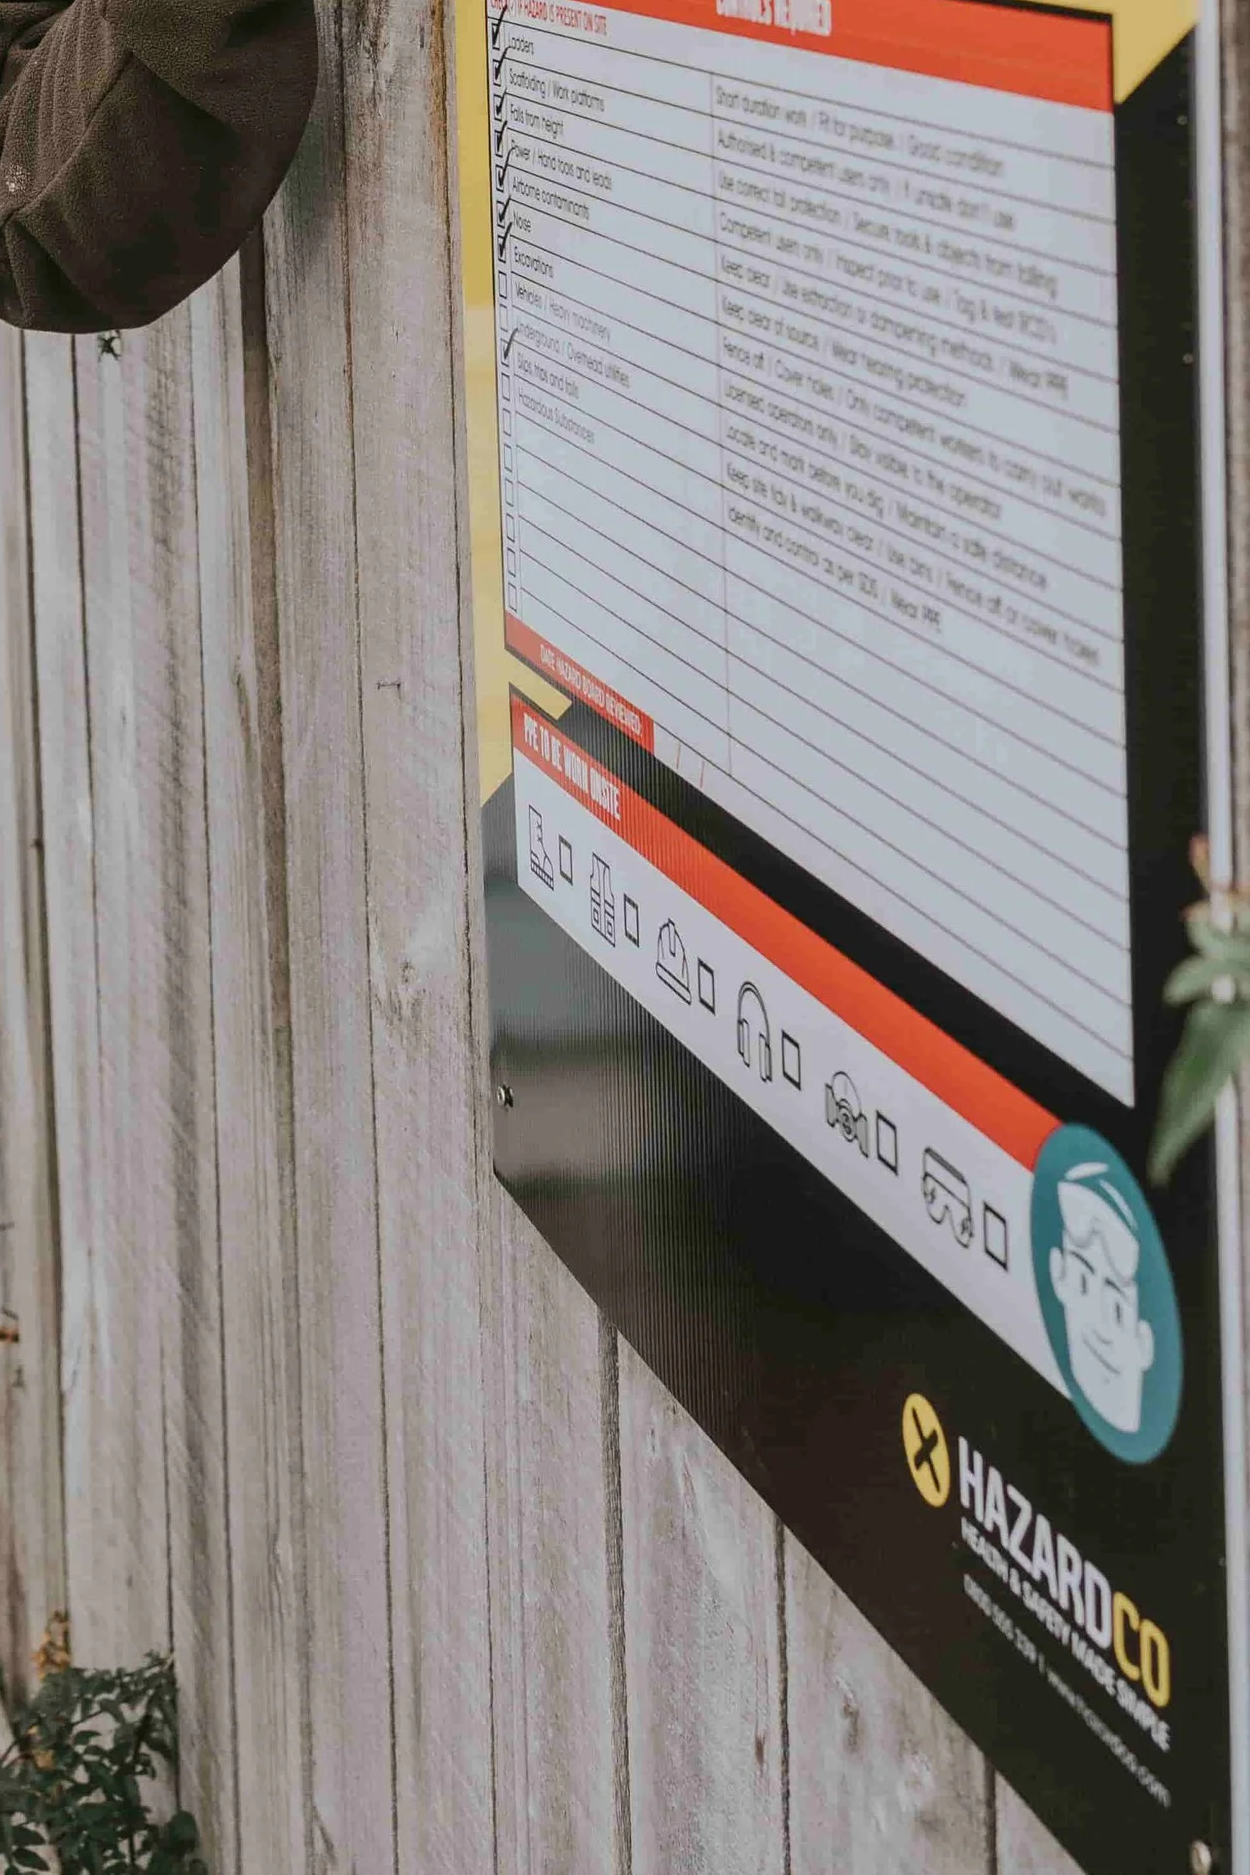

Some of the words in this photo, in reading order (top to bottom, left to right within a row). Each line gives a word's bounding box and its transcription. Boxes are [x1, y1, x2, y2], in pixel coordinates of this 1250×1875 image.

[513, 211, 532, 234] Noise
[523, 712, 539, 752] PPE
[539, 725, 550, 762] TO
[551, 734, 563, 773] BE
[563, 744, 588, 794] WORN
[958, 1434, 1171, 1708] HAZARDCO
